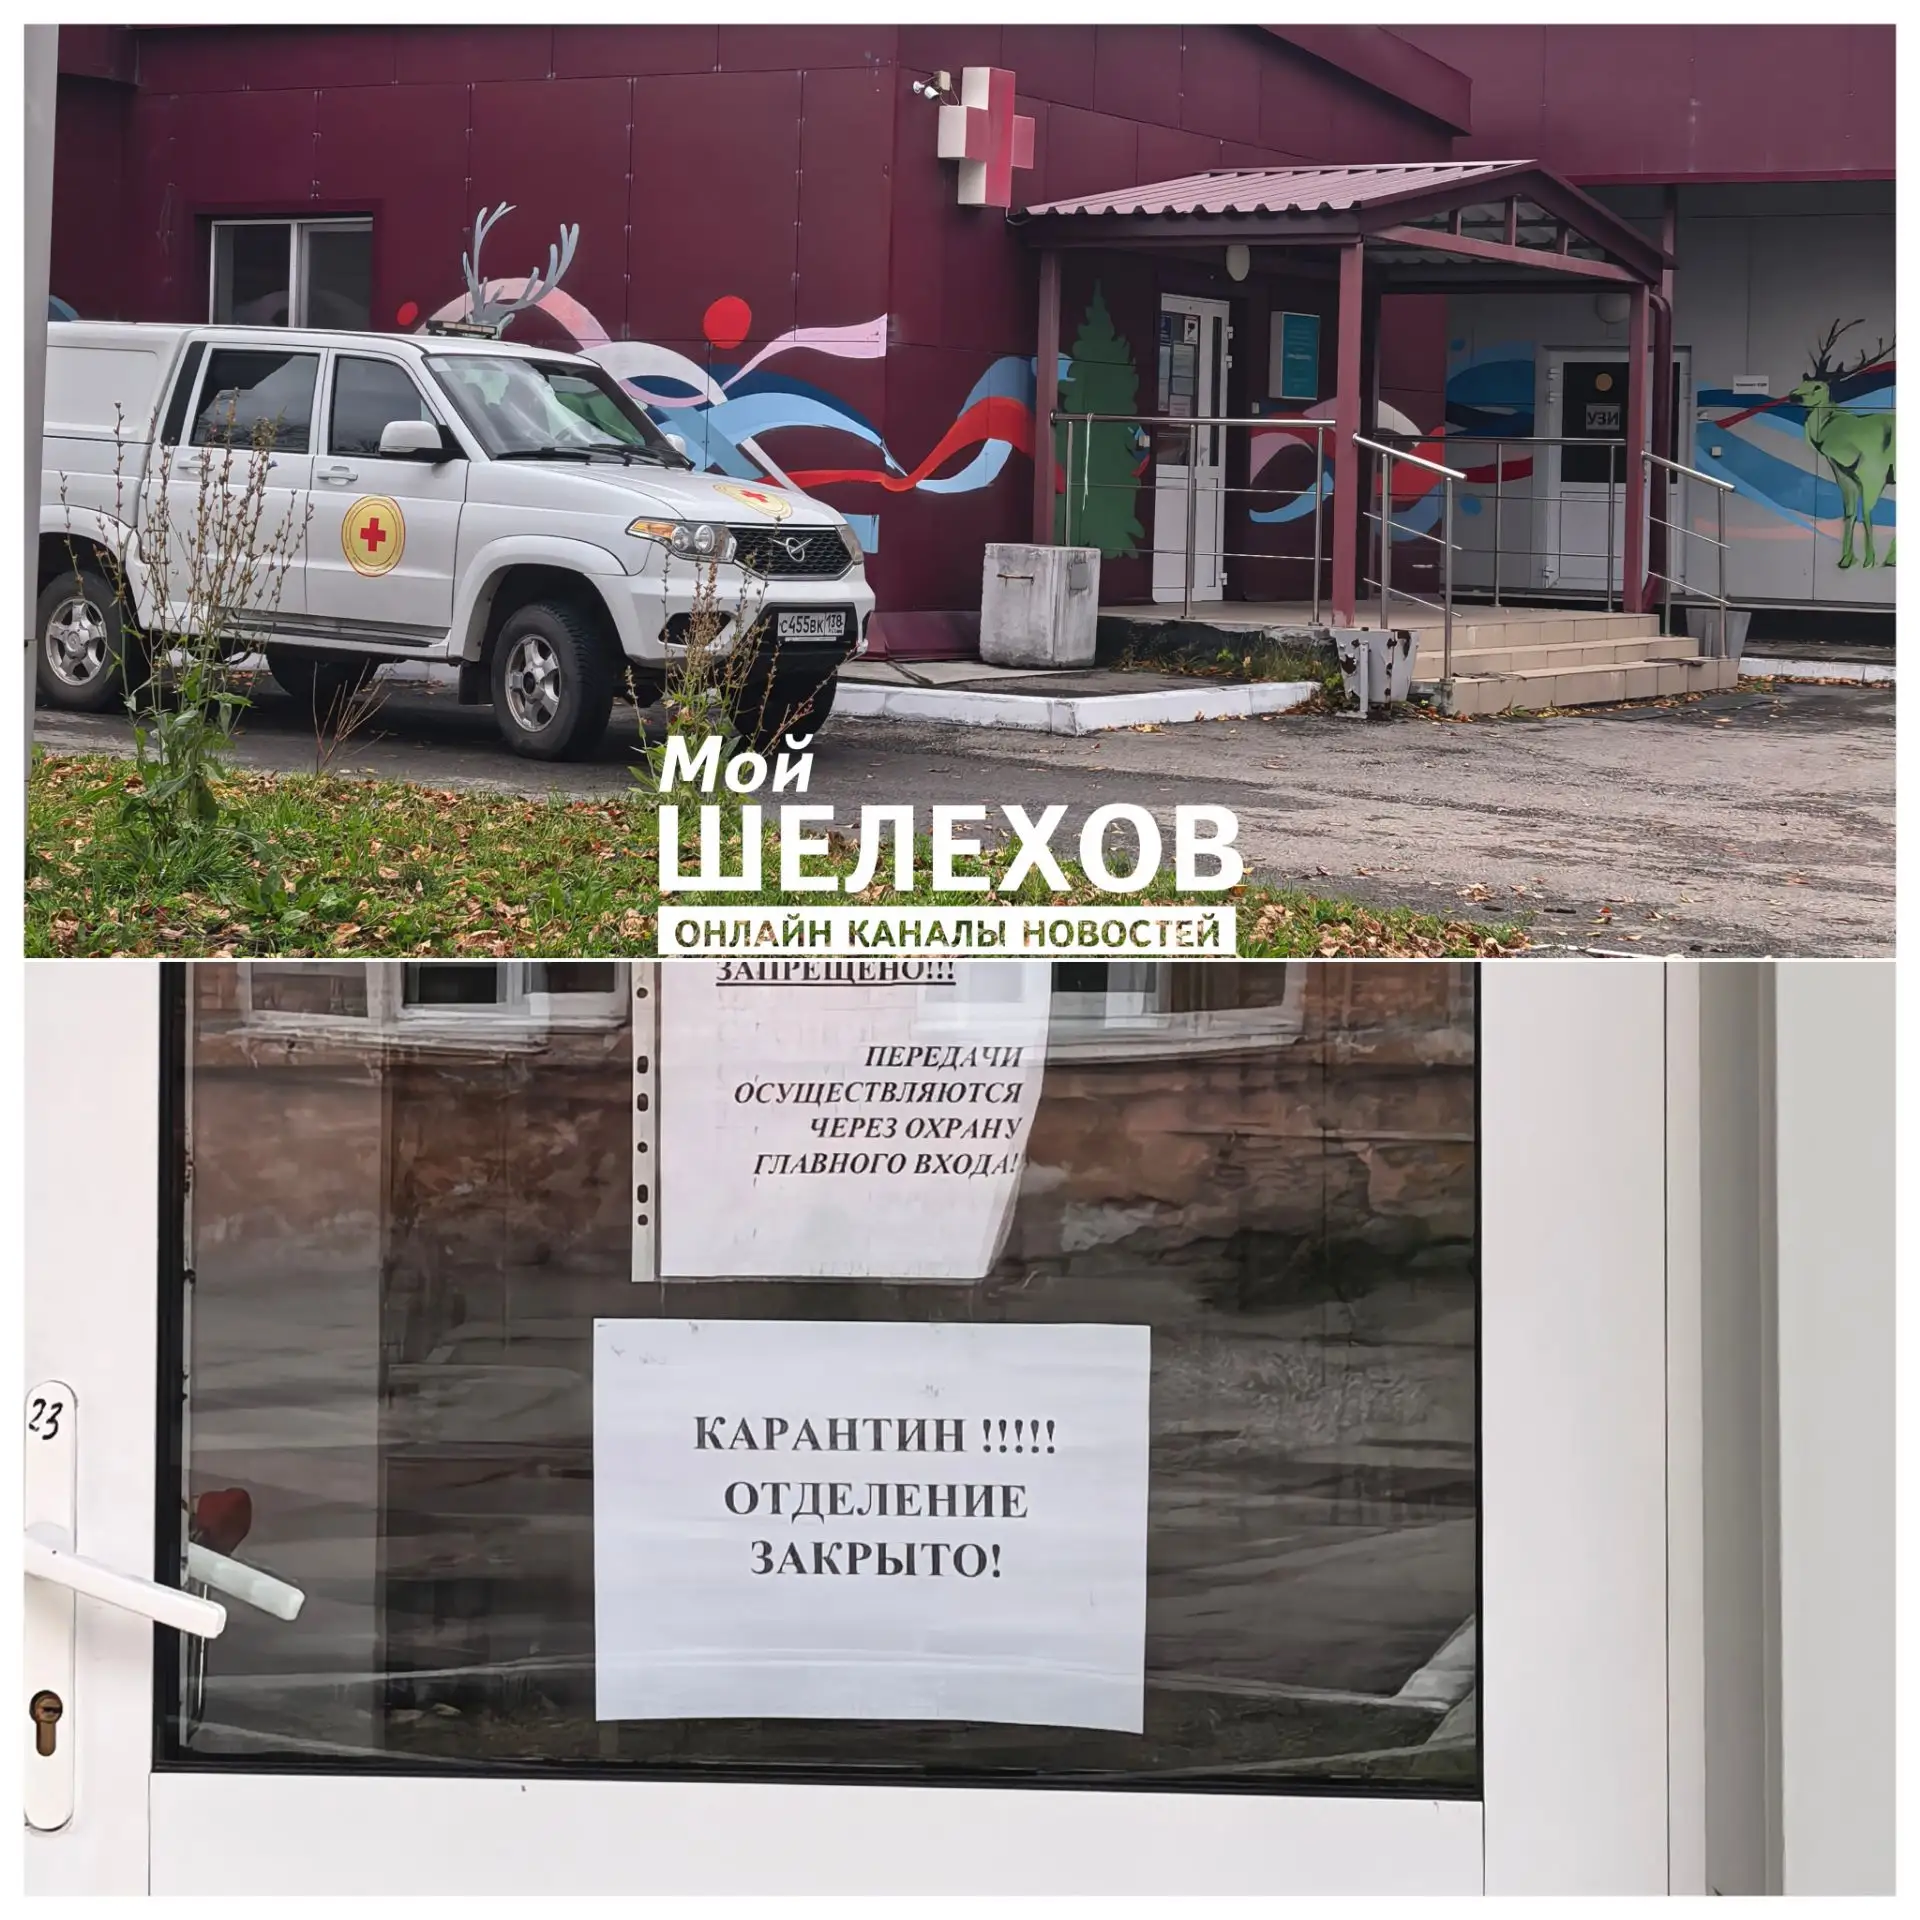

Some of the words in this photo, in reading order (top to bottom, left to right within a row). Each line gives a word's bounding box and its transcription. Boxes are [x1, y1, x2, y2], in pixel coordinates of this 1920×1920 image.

[1587, 411, 1619, 426] УЗИ
[865, 1045, 1023, 1070] ПЕРЕДАЧИ
[734, 1081, 1023, 1107] ОСУЩЕСТВЛЯЮТСЯ
[810, 1117, 897, 1139] ЧЕРЕЗ
[905, 1117, 1023, 1140] ОХРАНУ
[754, 1152, 906, 1175] ГЛАВНОГО
[914, 1152, 1019, 1178] ВХОДА!
[28, 1398, 63, 1440] 23
[694, 1416, 967, 1453] КАРАНТИН
[982, 1418, 1056, 1454] !!!!!
[724, 1481, 1029, 1524] ОТДЕЛЕНИЕ
[751, 1541, 1002, 1578] ЗАКРЫТО!
